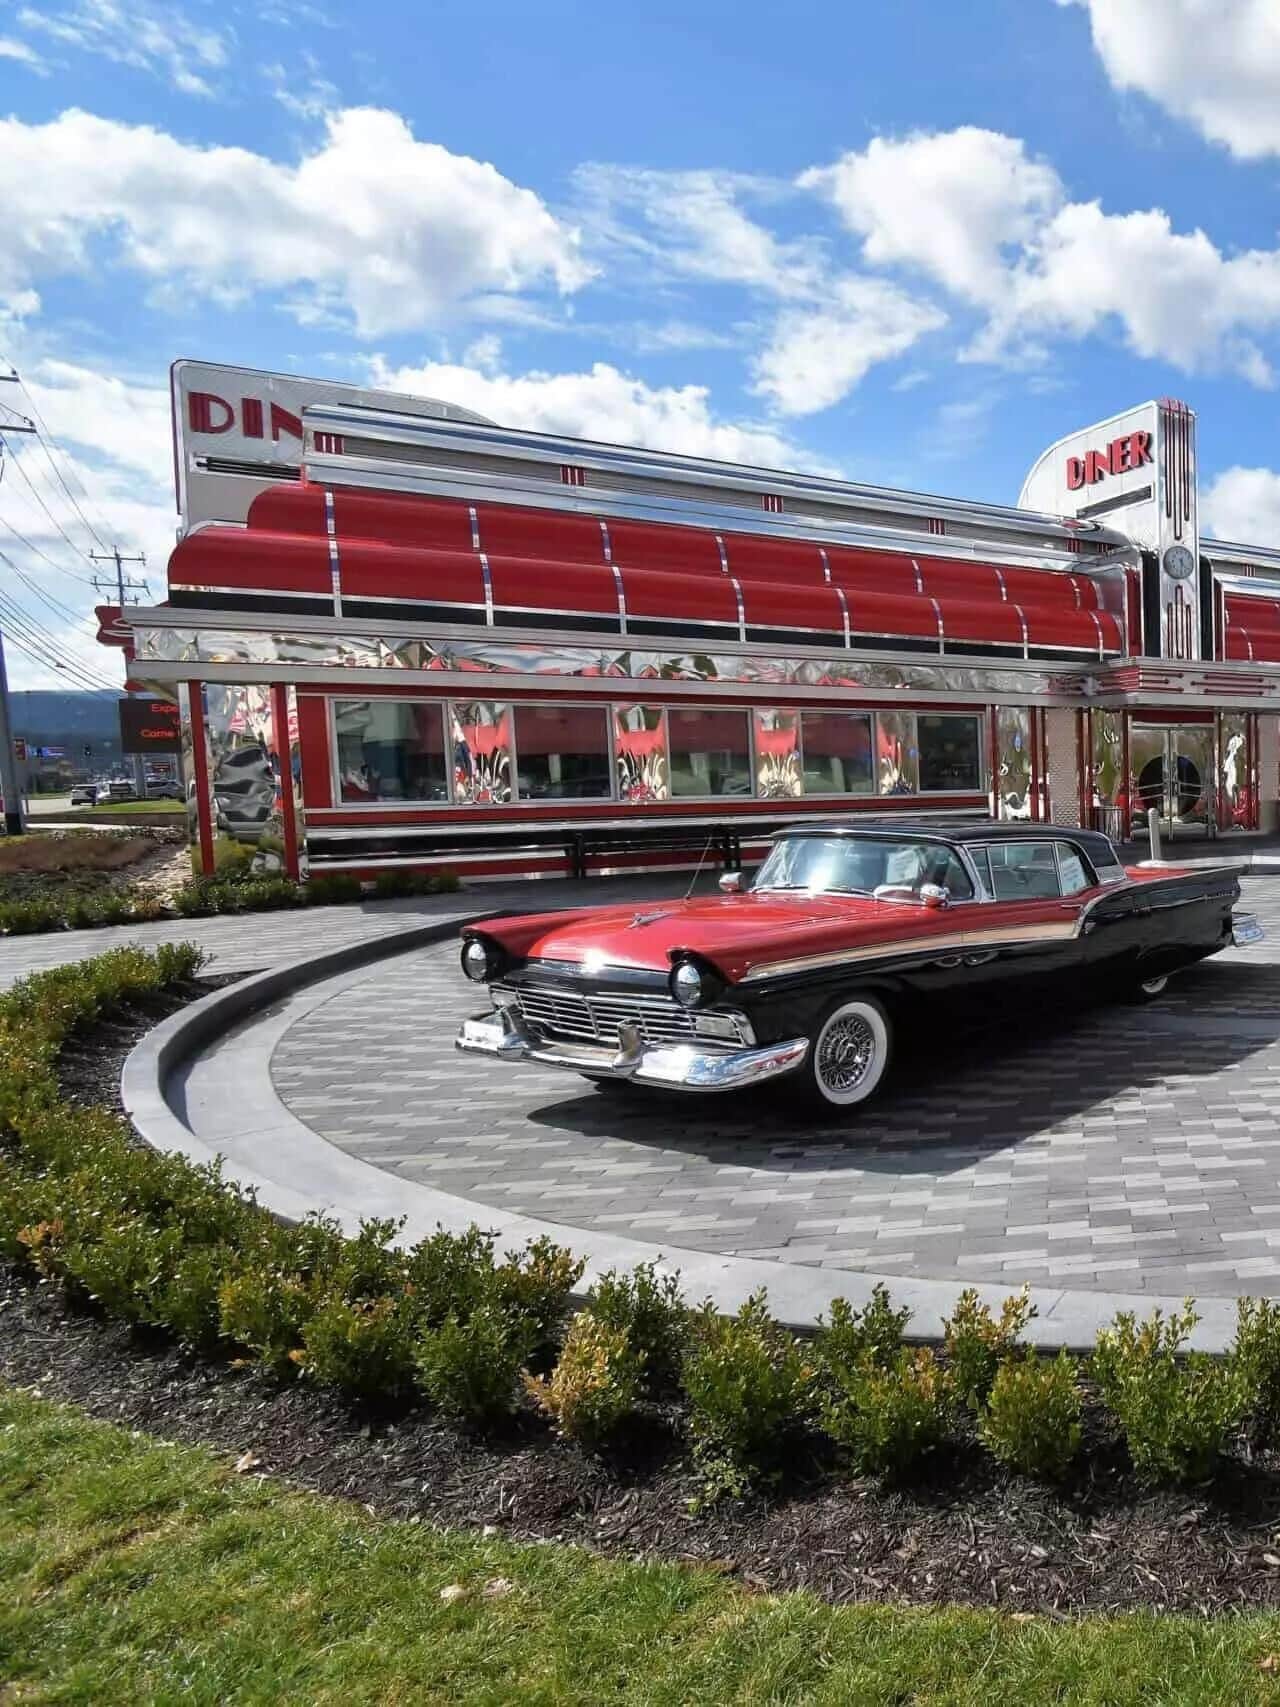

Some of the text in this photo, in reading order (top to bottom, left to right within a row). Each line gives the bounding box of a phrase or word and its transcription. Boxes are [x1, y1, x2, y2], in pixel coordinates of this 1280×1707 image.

[188, 391, 303, 441] DIN
[1066, 431, 1153, 490] DINER
[151, 703, 178, 715] Expe
